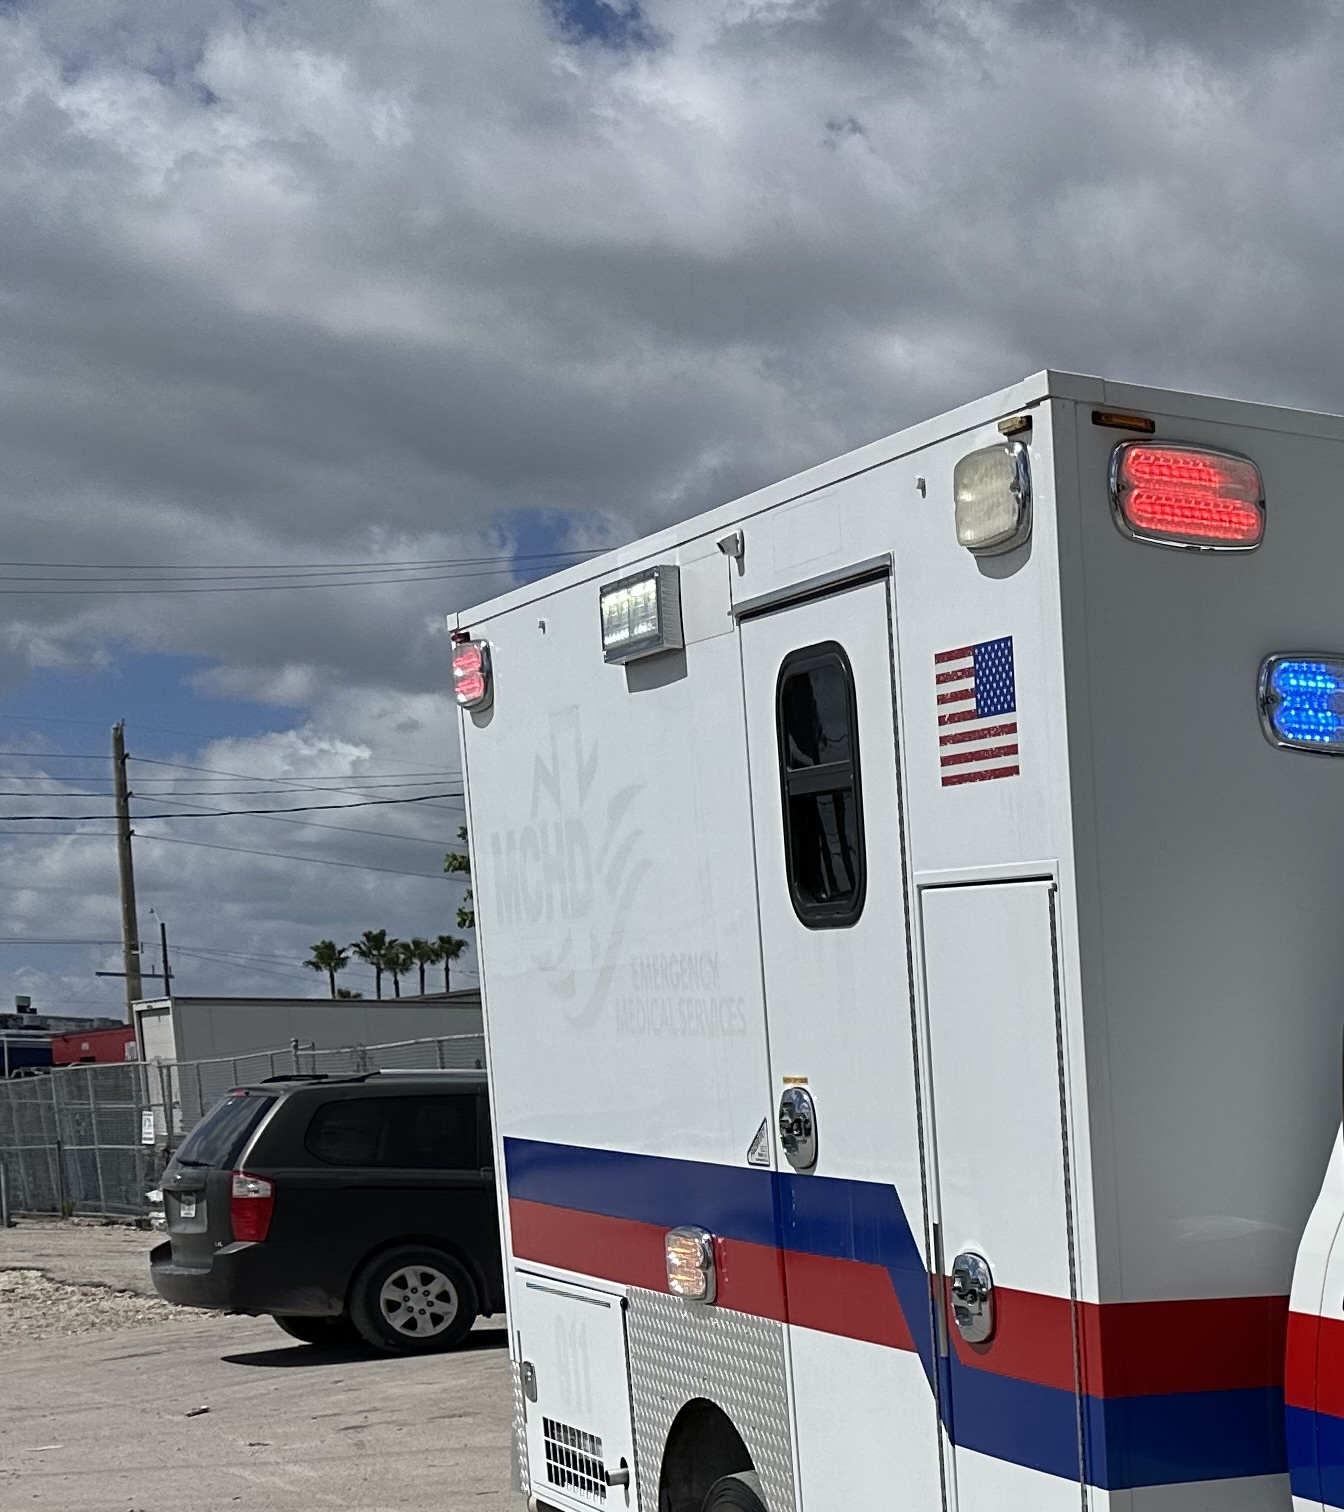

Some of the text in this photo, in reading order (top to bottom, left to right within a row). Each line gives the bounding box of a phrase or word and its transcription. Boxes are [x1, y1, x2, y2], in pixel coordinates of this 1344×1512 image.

[490, 819, 593, 924] MCHD
[630, 951, 720, 992] EMERGENCY
[615, 996, 747, 1038] MEDICAL SERVICES
